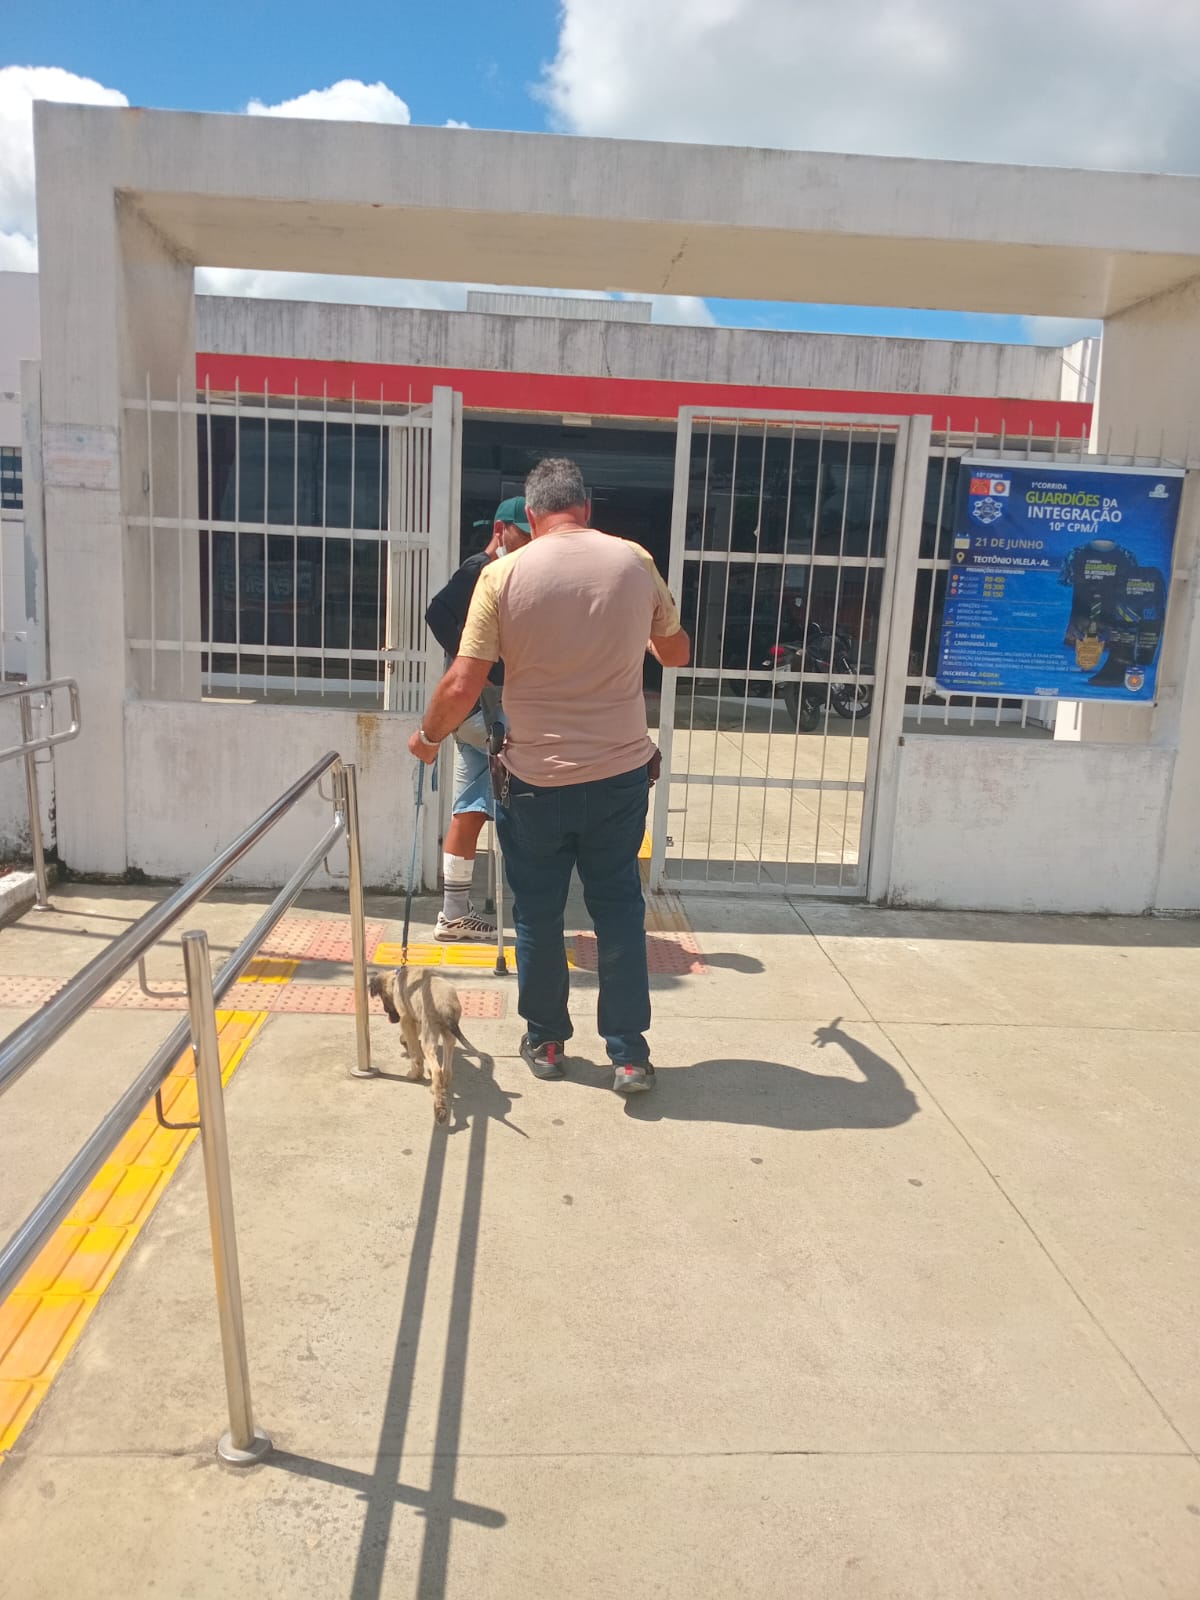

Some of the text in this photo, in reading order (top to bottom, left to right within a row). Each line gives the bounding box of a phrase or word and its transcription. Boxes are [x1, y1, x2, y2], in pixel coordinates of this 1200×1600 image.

[1025, 490, 1118, 508] GUARDIÕES DA
[1027, 505, 1122, 523] INTEGRAÇÃO
[1067, 522, 1099, 533] CPM/I
[975, 537, 1044, 550] 21 DE JUNHO
[973, 555, 1012, 565] TEOTÔNIO
[1012, 557, 1036, 566] VILELA
[1040, 559, 1050, 567] AL
